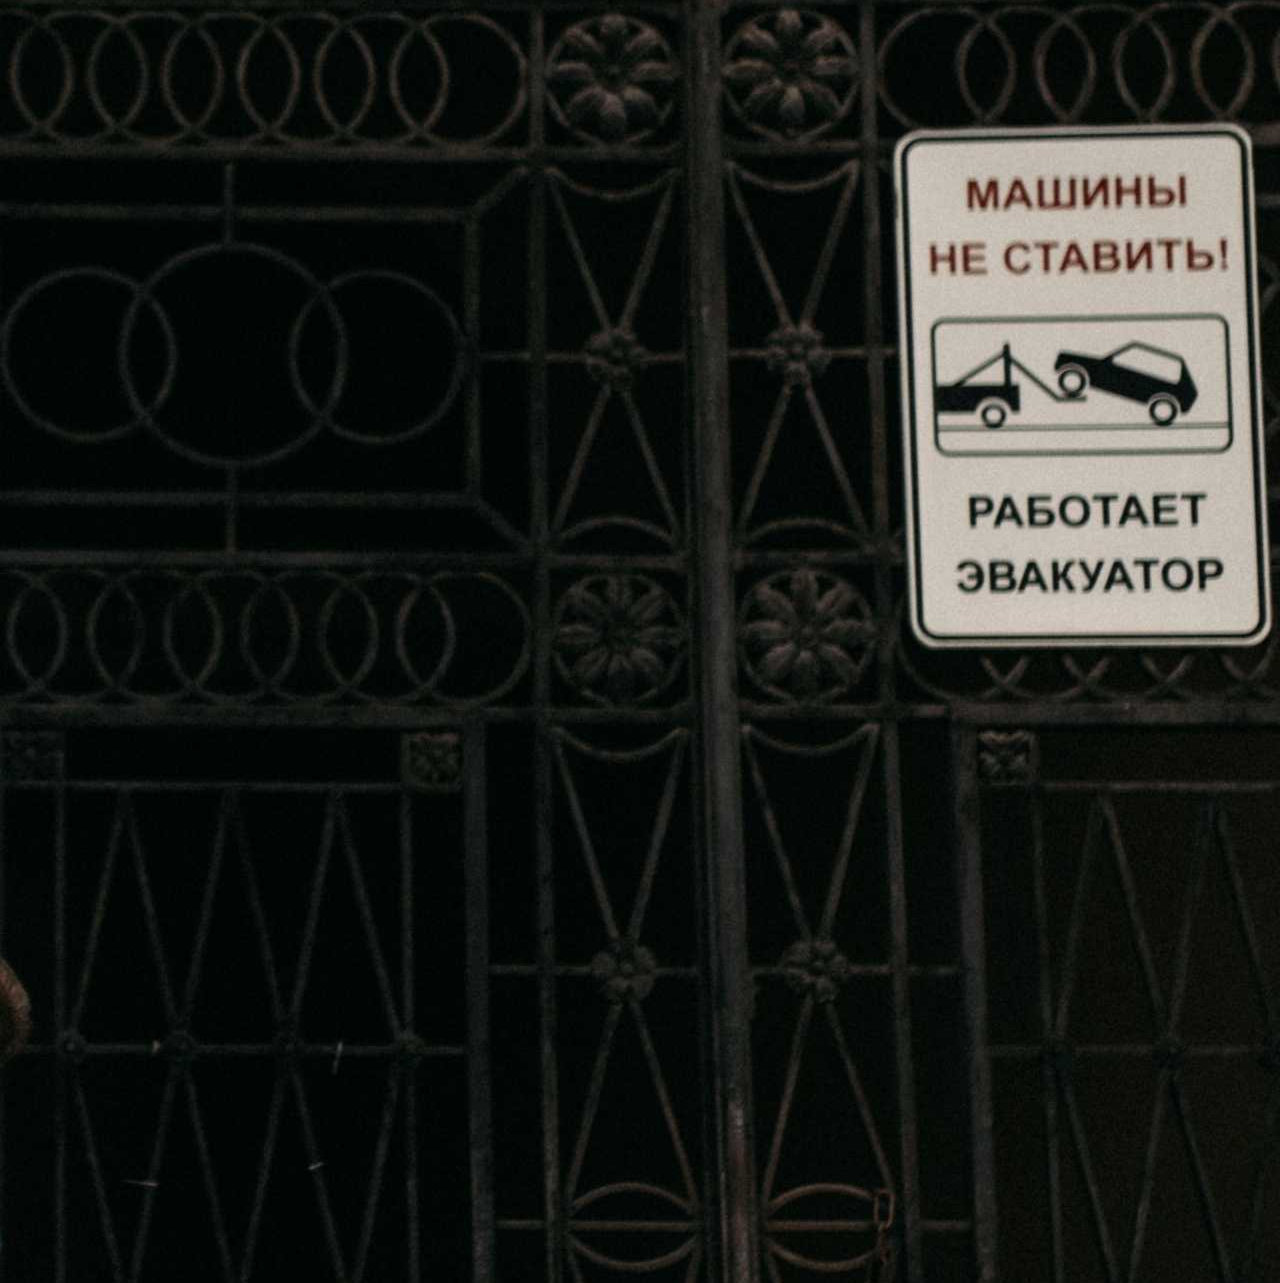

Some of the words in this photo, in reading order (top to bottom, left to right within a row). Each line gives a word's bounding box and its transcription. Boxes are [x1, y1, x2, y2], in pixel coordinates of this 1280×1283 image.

[966, 174, 1188, 211] МАШИНЫ
[929, 242, 987, 275] НЕ
[1003, 237, 1228, 275] СТАВИТЬ!
[968, 492, 1208, 529] РАБОТАЕТ
[956, 557, 1225, 595] ЭВАКУАТОР
